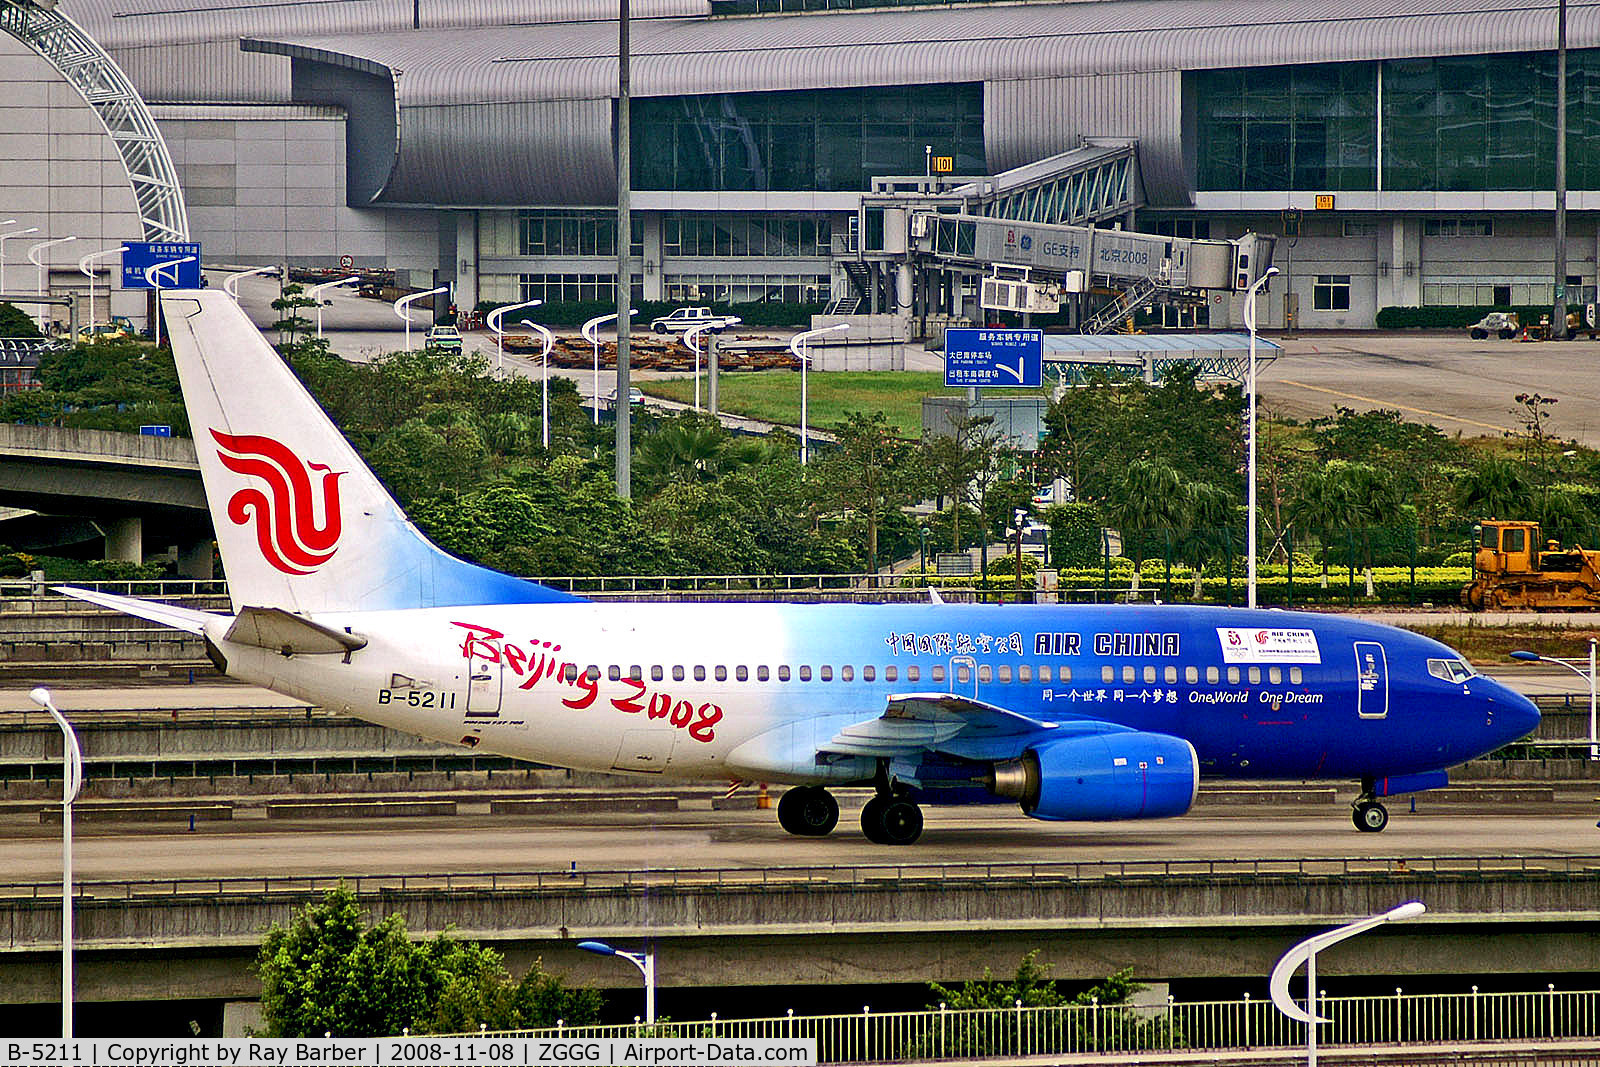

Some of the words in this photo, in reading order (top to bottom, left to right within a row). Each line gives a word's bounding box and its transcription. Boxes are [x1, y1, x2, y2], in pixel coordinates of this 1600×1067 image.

[938, 158, 951, 170] 101
[1043, 241, 1080, 259] GE支持
[1100, 247, 1148, 265] 北京2008
[979, 332, 1039, 342] 服务车辆专用道
[885, 631, 1024, 656] 中国国际航空公司
[1034, 632, 1081, 655] AIR
[1094, 633, 1180, 656] CHINA
[450, 621, 601, 710] Beijing
[609, 677, 724, 743] 2008
[378, 689, 456, 710] B-5211
[1042, 688, 1108, 703] 同一个世界
[1113, 688, 1178, 704] 同一个梦想
[1189, 690, 1212, 703] One
[1214, 690, 1249, 703] World
[1259, 690, 1283, 703] One
[1285, 690, 1324, 703] Dream
